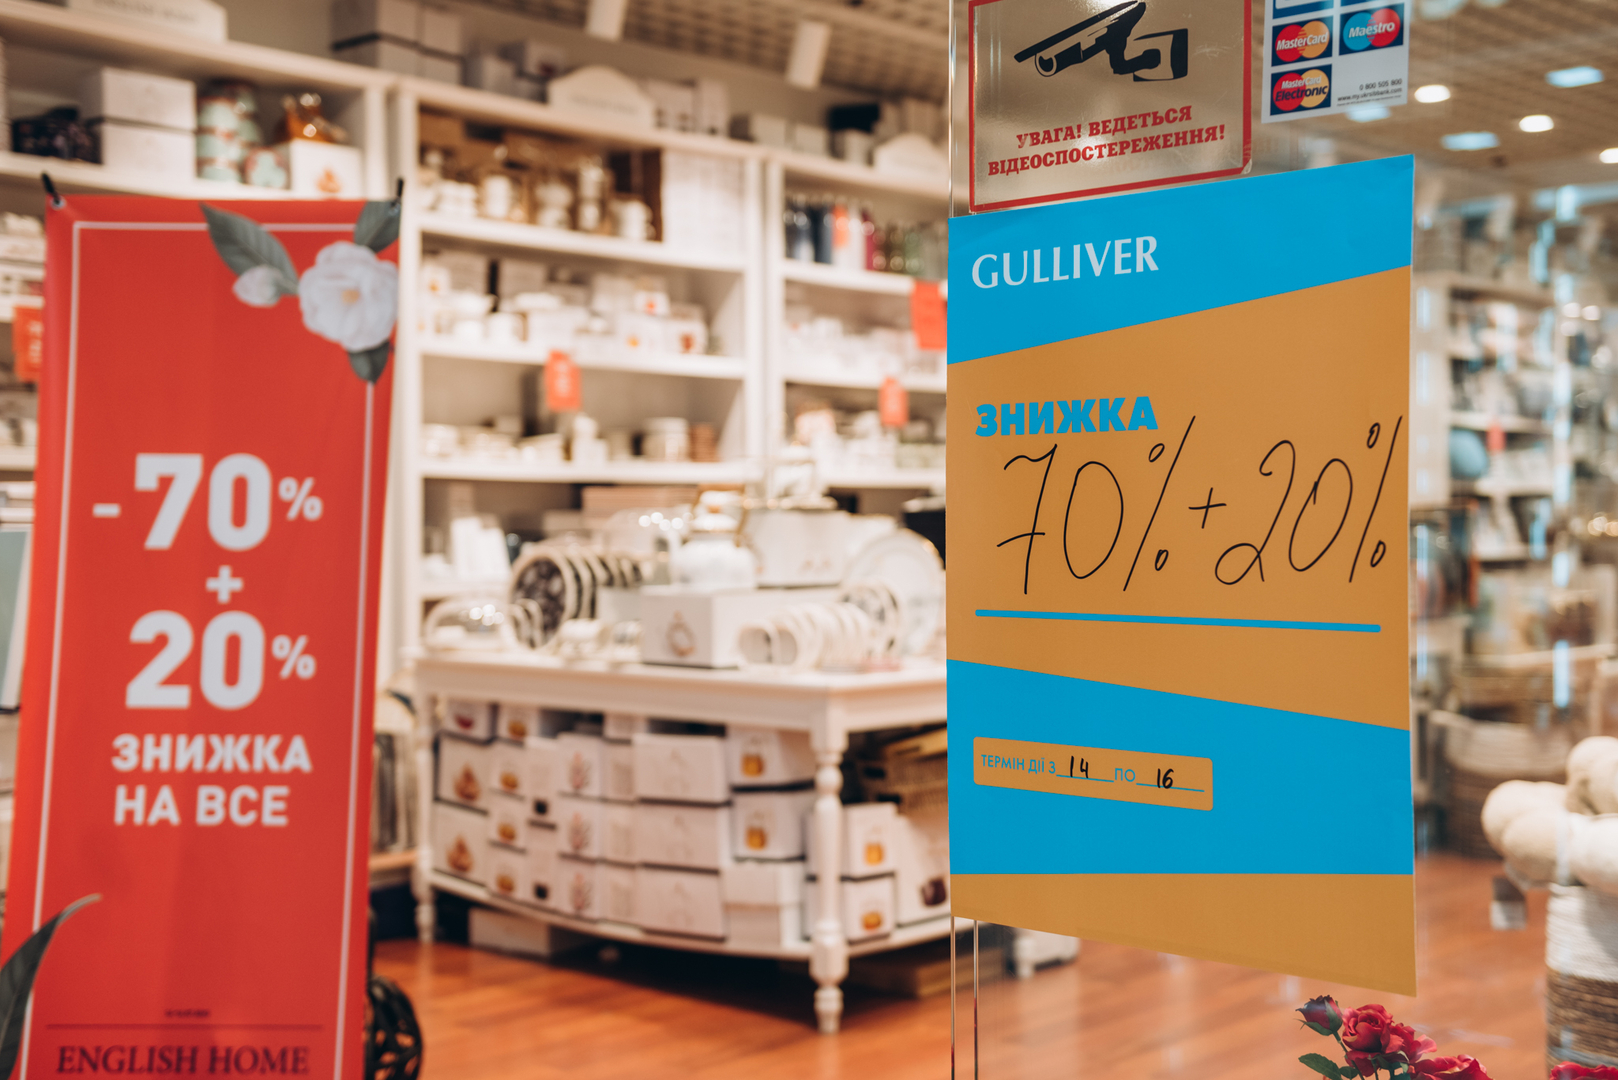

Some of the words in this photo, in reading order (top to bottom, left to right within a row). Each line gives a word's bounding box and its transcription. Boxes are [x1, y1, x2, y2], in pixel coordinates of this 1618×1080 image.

[1276, 32, 1328, 51] MasterCard
[1348, 22, 1396, 38] Maestro
[1281, 75, 1322, 90] MasterCard
[1016, 124, 1083, 149] УВАГА!
[1088, 105, 1193, 137] ВЕДЕТЬСЯ
[988, 124, 1226, 176] ВІДЕОСПОСТЕРЕЖЕННЯ!
[972, 236, 1159, 289] GULLIVER
[975, 396, 1159, 437] ЗНИЖКА
[125, 609, 317, 710] 20%
[111, 733, 313, 773] ЗНИЖКА
[981, 754, 1025, 771] ТЕРМІН
[1028, 757, 1045, 774] ДІЇ
[1069, 755, 1089, 779] 14
[1114, 767, 1136, 782] ПО
[1156, 768, 1175, 789] 16
[114, 784, 181, 826] НА
[196, 784, 290, 827] ВСЕ
[56, 1044, 198, 1075] ENGLISH
[208, 1044, 310, 1075] HOME
